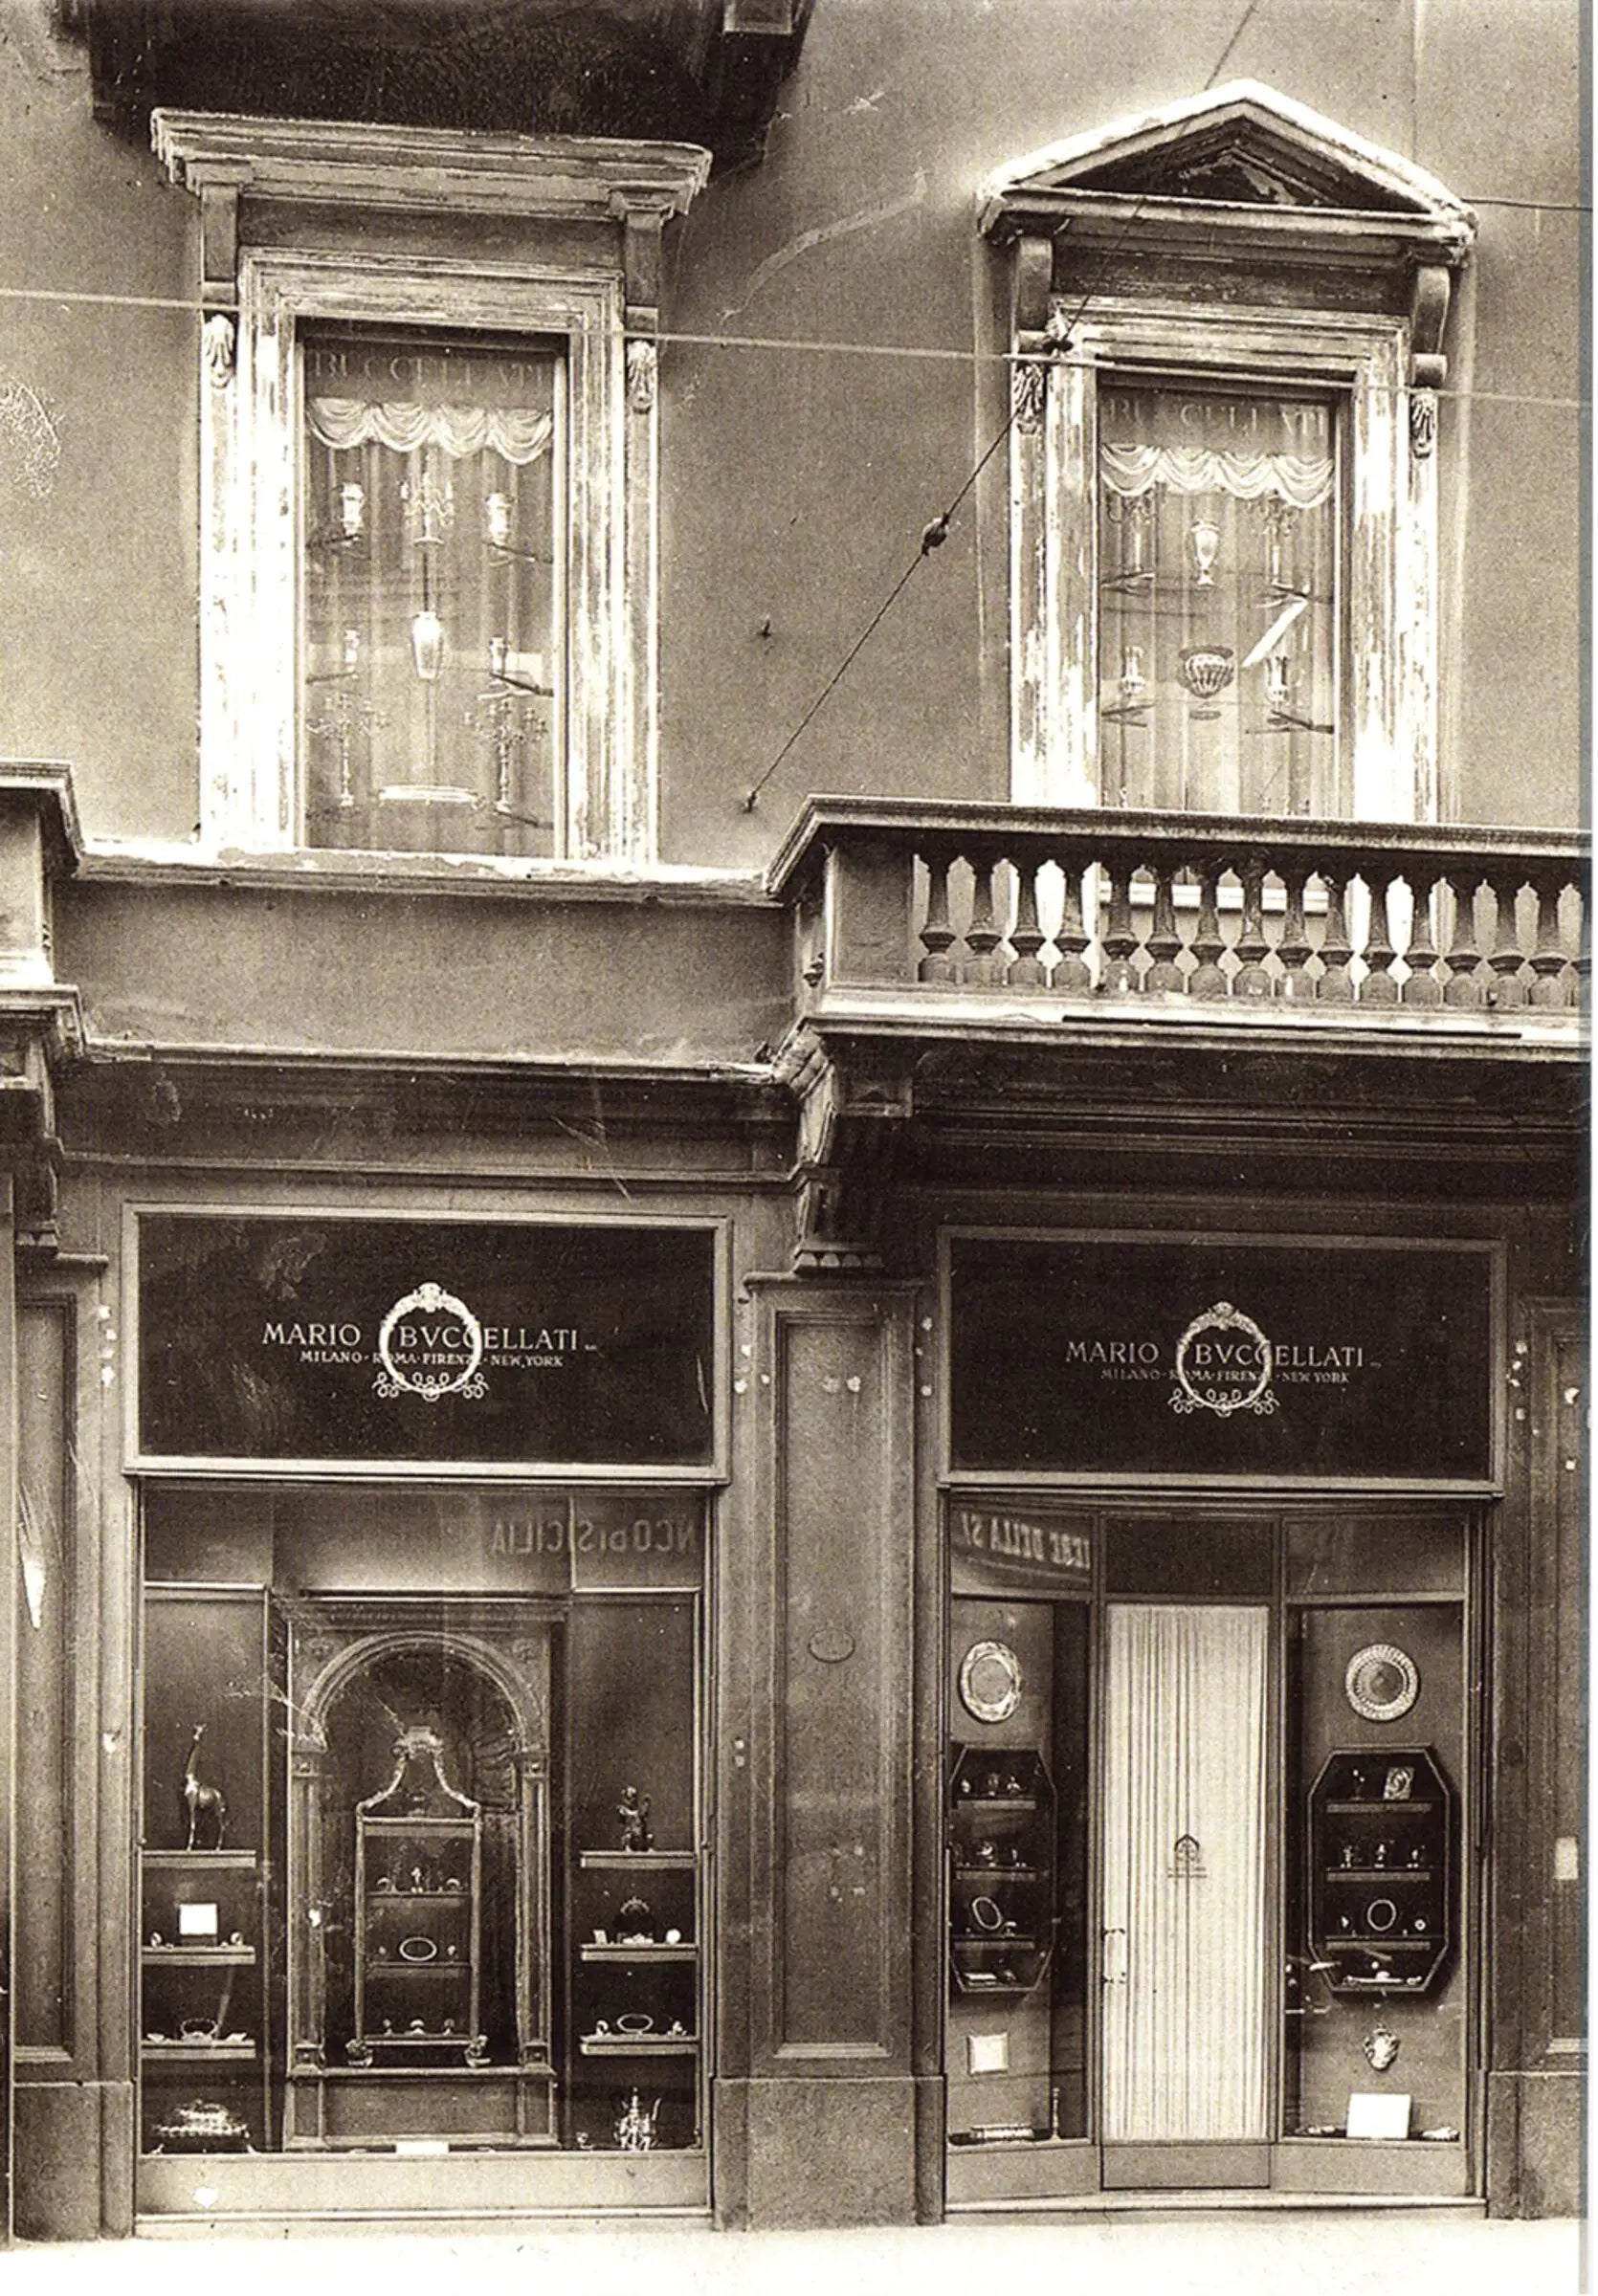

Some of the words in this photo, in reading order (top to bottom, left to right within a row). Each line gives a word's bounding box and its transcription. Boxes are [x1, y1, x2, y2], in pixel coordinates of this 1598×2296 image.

[261, 1322, 362, 1347] MARIO
[300, 1351, 363, 1364] MILANO
[372, 1352, 417, 1365] RMA
[422, 1353, 482, 1366] FIRENZ
[525, 1355, 564, 1368] YORK
[1064, 1340, 1160, 1365] MARIO
[1100, 1368, 1162, 1381] MILANO
[1314, 1371, 1350, 1384] YORK
